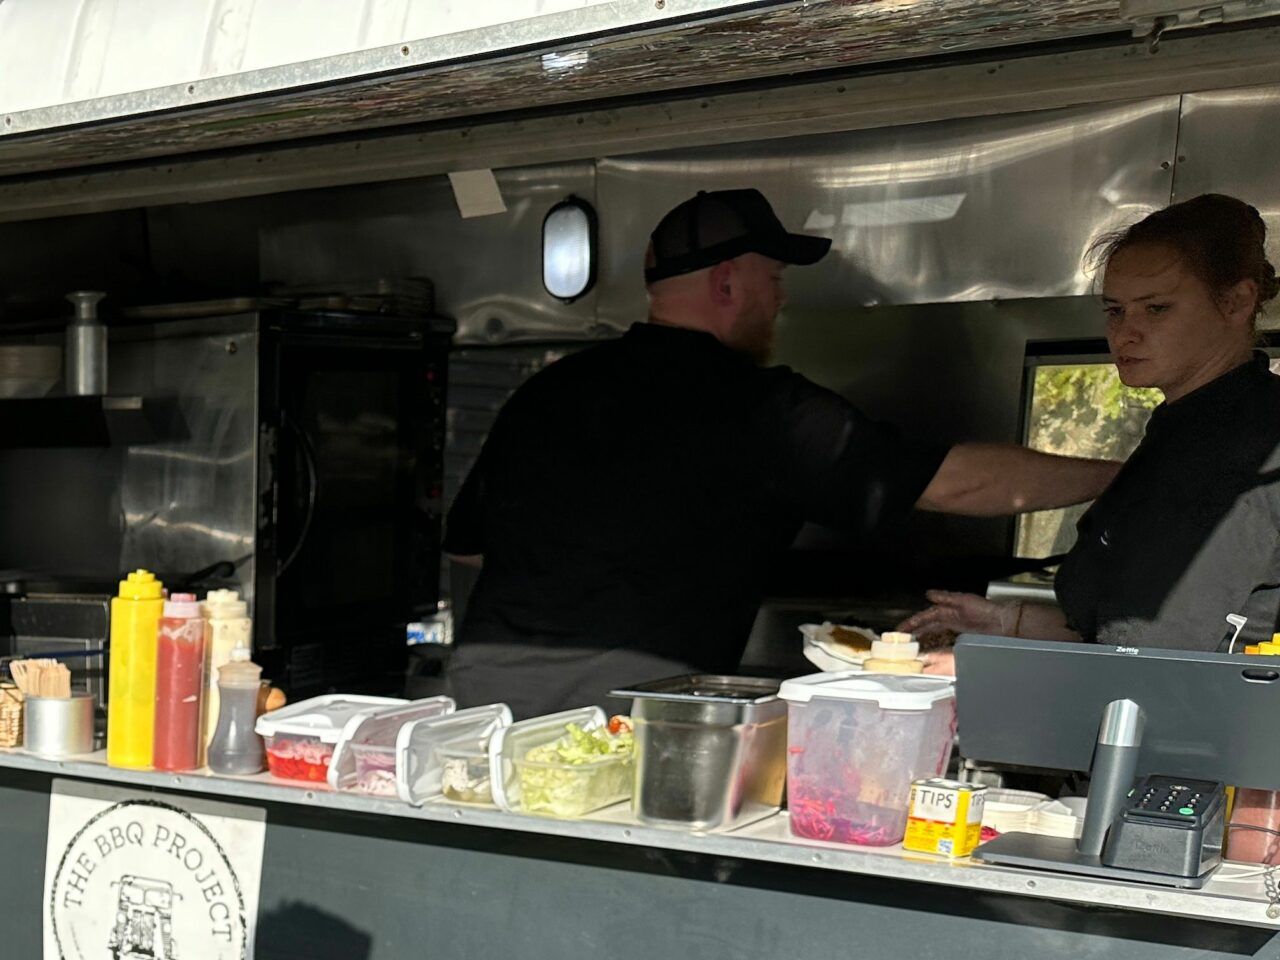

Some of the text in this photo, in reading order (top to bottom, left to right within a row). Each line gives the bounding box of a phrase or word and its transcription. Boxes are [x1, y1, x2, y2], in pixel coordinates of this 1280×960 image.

[920, 790, 954, 808] TIPS
[64, 820, 232, 943] THE BBQ PROJECT
